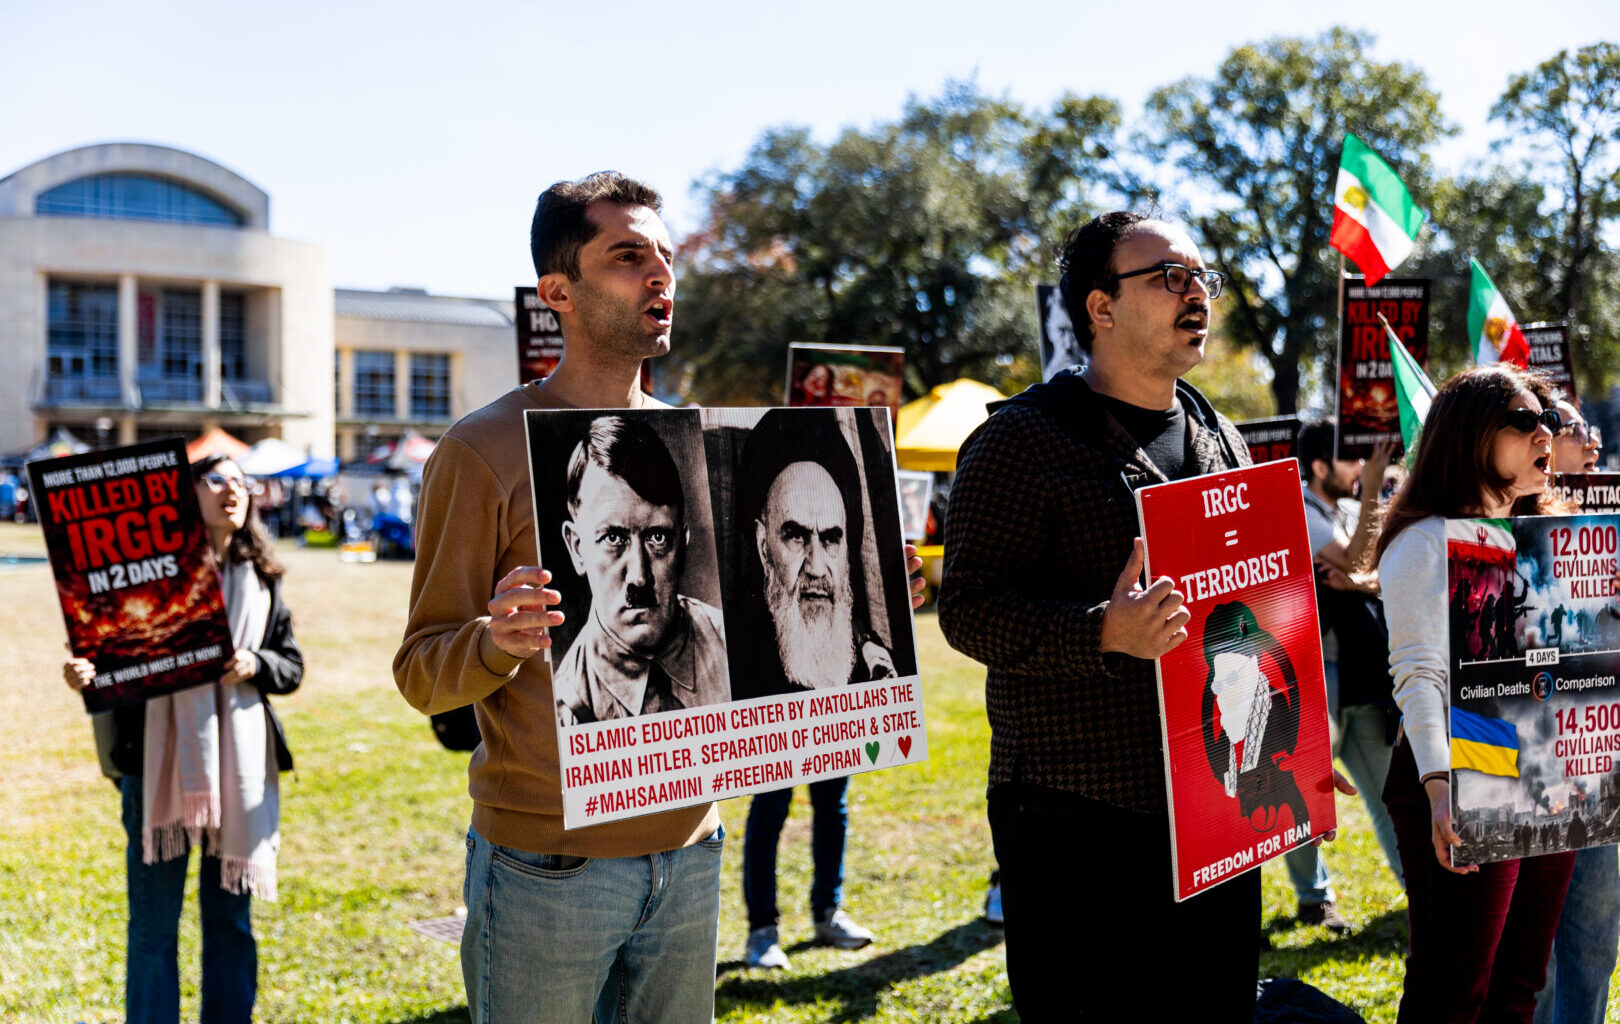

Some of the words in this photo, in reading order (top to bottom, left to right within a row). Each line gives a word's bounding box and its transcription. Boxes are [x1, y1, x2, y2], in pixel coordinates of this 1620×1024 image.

[1401, 300, 1422, 325] BY
[1356, 363, 1367, 378] IN
[1368, 361, 1377, 378] 2
[42, 469, 75, 488] MORE
[75, 465, 104, 482] THAN
[103, 457, 138, 477] 12,000
[138, 451, 178, 470] PEOPLE
[48, 477, 143, 524] KILLED
[144, 470, 179, 504] BY
[1202, 482, 1250, 518] IRGC
[66, 505, 184, 571] IRGC
[1549, 525, 1617, 560] 12,000
[88, 570, 111, 594] IN
[109, 563, 128, 589] 2
[127, 554, 179, 586] DAYS
[1180, 549, 1290, 604] TERRORIST
[1553, 557, 1617, 579] CIVILIANS
[1571, 578, 1617, 599] KILLED
[112, 663, 149, 683] WORLD
[148, 656, 176, 674] MUST
[176, 651, 195, 668] ACT
[1529, 652, 1535, 663] 4
[1536, 650, 1556, 663] DAYS
[1460, 685, 1495, 700] Civilian
[1497, 681, 1531, 697] Deaths
[1555, 674, 1615, 692] Comparison
[569, 725, 637, 756] ISLAMIC
[642, 712, 727, 744] EDUCATION
[731, 703, 784, 730] CENTER
[788, 699, 804, 720] BY
[809, 687, 887, 717] AYATOLLAHS
[890, 683, 914, 704] THE
[1555, 703, 1620, 738] 14,500
[566, 758, 633, 789] IRANIAN
[638, 748, 697, 776] HITLER.
[701, 731, 788, 765] SEPARATION
[792, 728, 809, 749] OF
[813, 718, 866, 746] CHURCH
[870, 717, 879, 735] &
[882, 710, 921, 733] STATE.
[1555, 735, 1620, 759] CIVILIANS
[585, 776, 703, 817] #MAHSAAMINI
[712, 759, 793, 793] #FREEIRAN
[801, 748, 861, 776] #OPIRAN
[1565, 755, 1612, 778] KILLED
[1193, 847, 1254, 887] FREEDOM
[1257, 835, 1281, 859] FOR
[1283, 821, 1311, 847] IRAN
